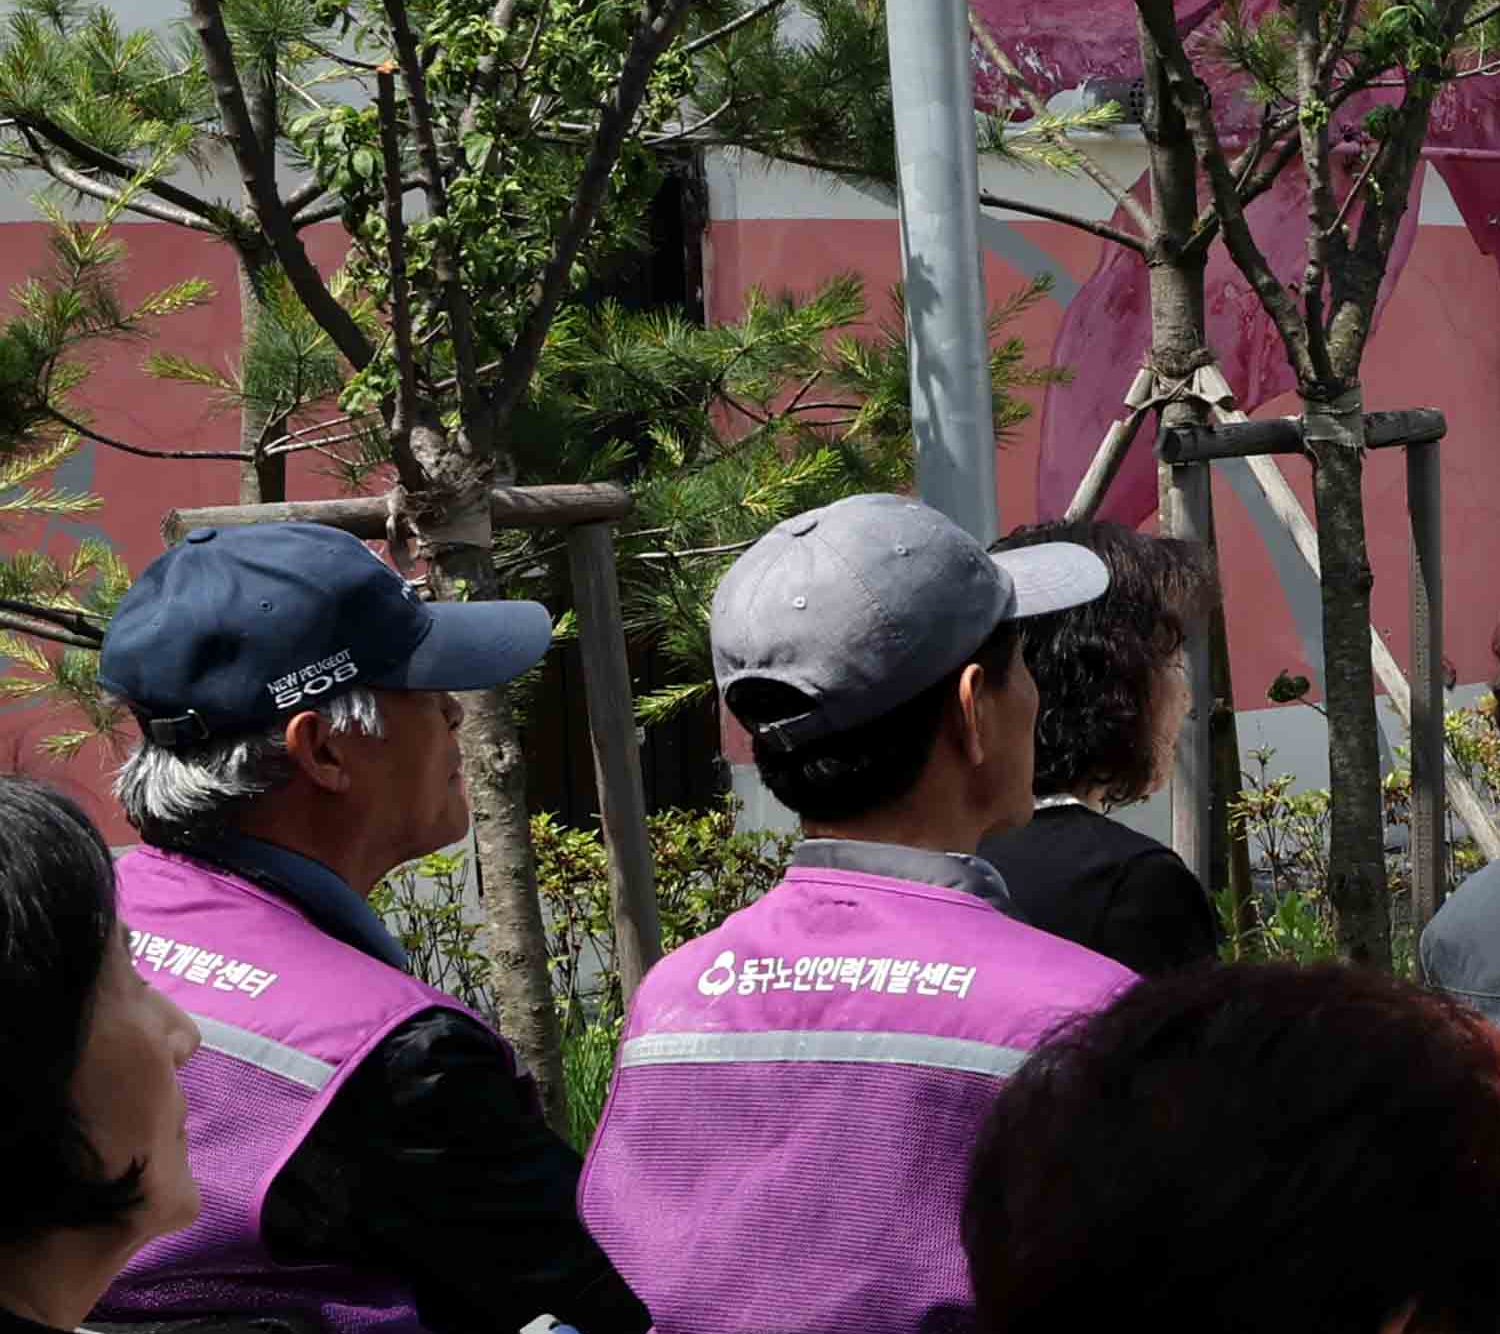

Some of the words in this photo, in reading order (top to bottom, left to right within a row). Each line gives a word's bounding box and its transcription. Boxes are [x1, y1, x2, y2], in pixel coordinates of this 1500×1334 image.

[266, 671, 299, 695] NEW
[298, 648, 351, 682] PEUGEOT
[275, 661, 360, 710] 508
[737, 956, 976, 999] 동구노인인력개발센터
